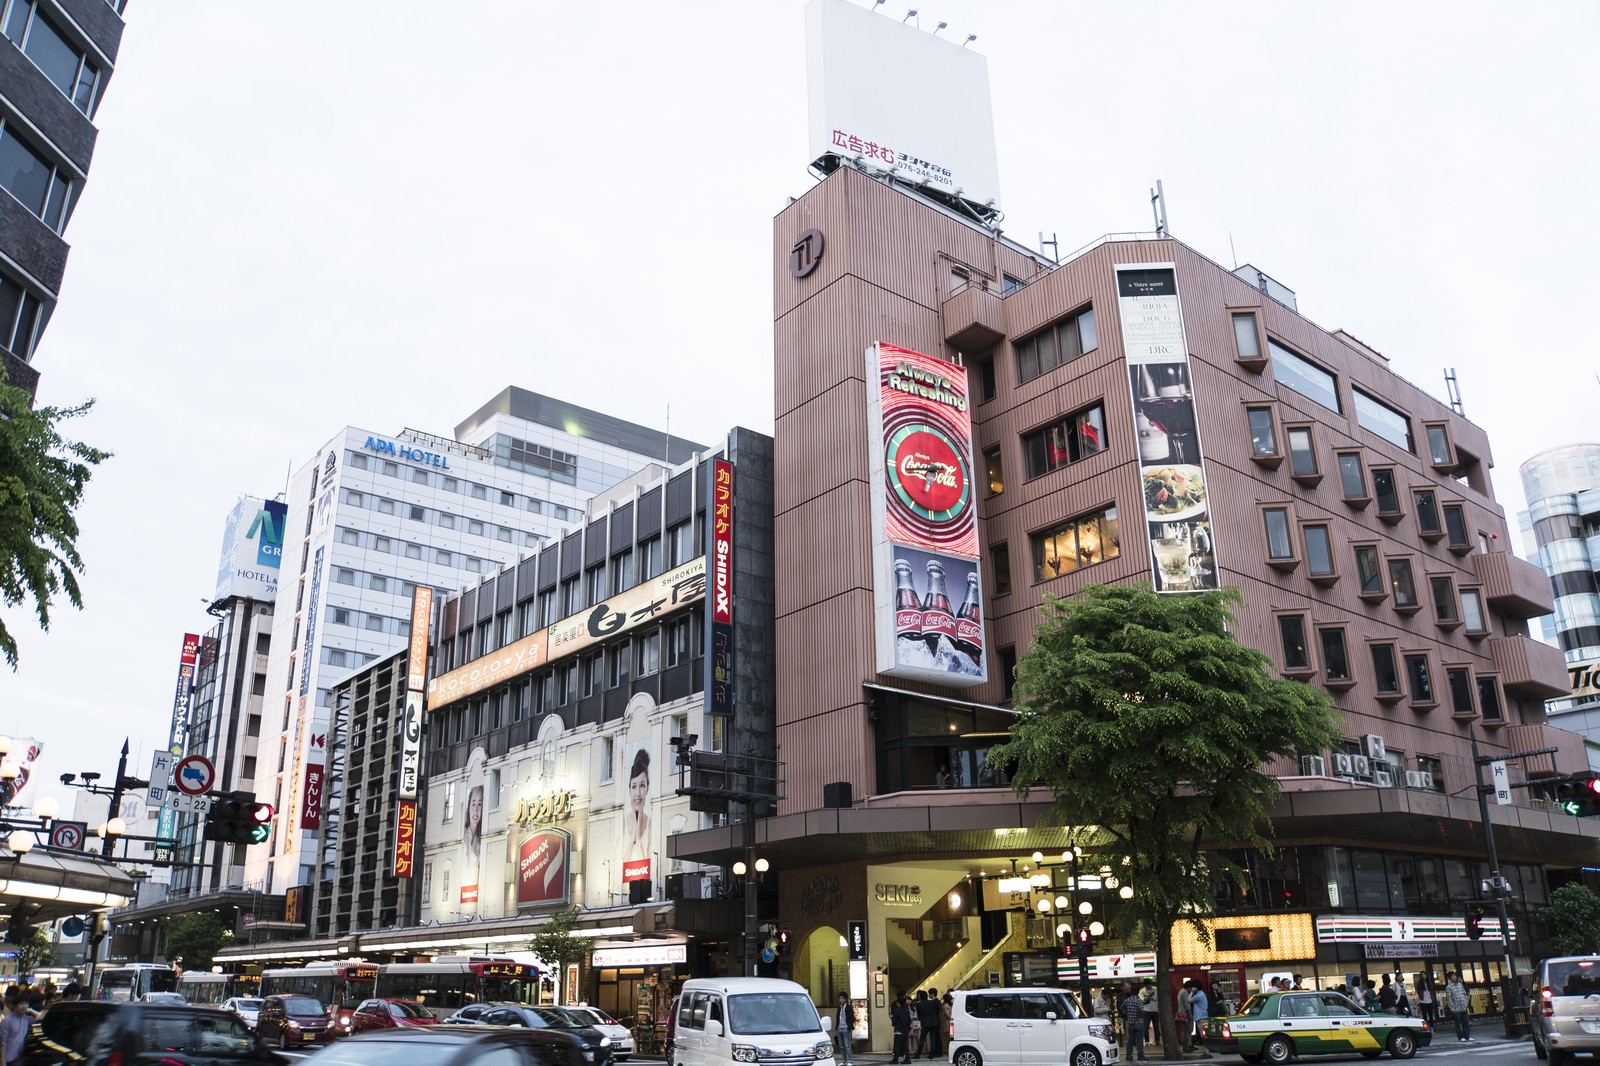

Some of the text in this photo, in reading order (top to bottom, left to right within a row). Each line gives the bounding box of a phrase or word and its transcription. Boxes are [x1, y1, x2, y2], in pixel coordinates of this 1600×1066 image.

[832, 129, 895, 164] 広告求む
[895, 361, 952, 388] Always
[888, 373, 967, 412] Refreshing
[364, 436, 450, 470] APA HOTEL
[901, 454, 957, 488] CocaCola
[716, 468, 730, 534] カラオケ
[237, 569, 271, 583] HOTEL
[662, 563, 703, 587] SHIROKIYA
[717, 539, 729, 615] SHIDAX
[587, 573, 706, 637] 白木屋
[173, 695, 188, 744] サウナ片町
[150, 756, 169, 801] 片町
[305, 772, 319, 818] きんしん
[1495, 766, 1508, 800] 片町
[396, 805, 415, 873] カラオケ
[520, 839, 549, 871] SHIDAX
[523, 853, 550, 883] Please!
[624, 866, 649, 877] SHIDAX
[461, 890, 478, 899] SHIDAX
[875, 882, 910, 902] SEKI
[1109, 957, 1121, 976] 7
